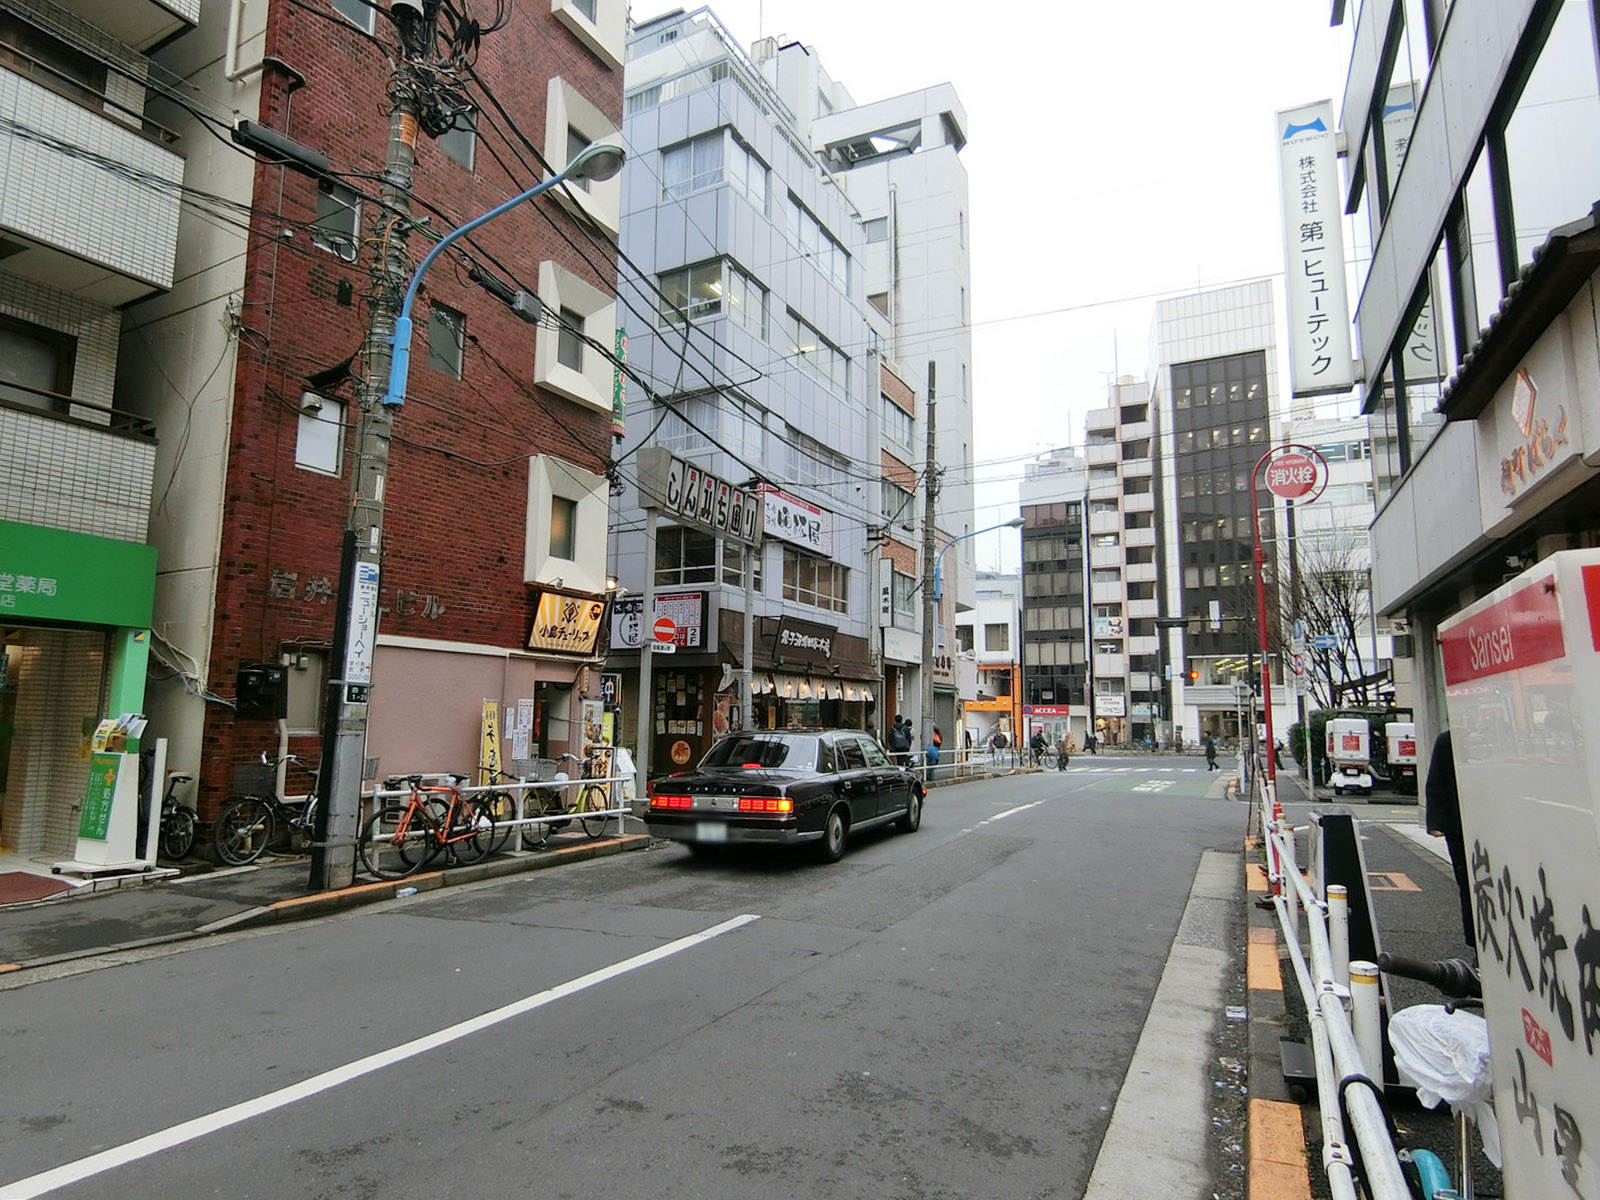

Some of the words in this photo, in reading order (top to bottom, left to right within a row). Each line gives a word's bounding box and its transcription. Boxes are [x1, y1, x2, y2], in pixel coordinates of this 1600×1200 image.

[1298, 155, 1318, 214] 株式会社
[1299, 221, 1332, 376] 第一ヒューテック
[1270, 466, 1314, 487] 消火栓
[667, 472, 755, 538] しんみち通り
[539, 624, 590, 643] 小島チューリップ
[1468, 624, 1515, 672] Sansei
[95, 787, 112, 836] 処方せん
